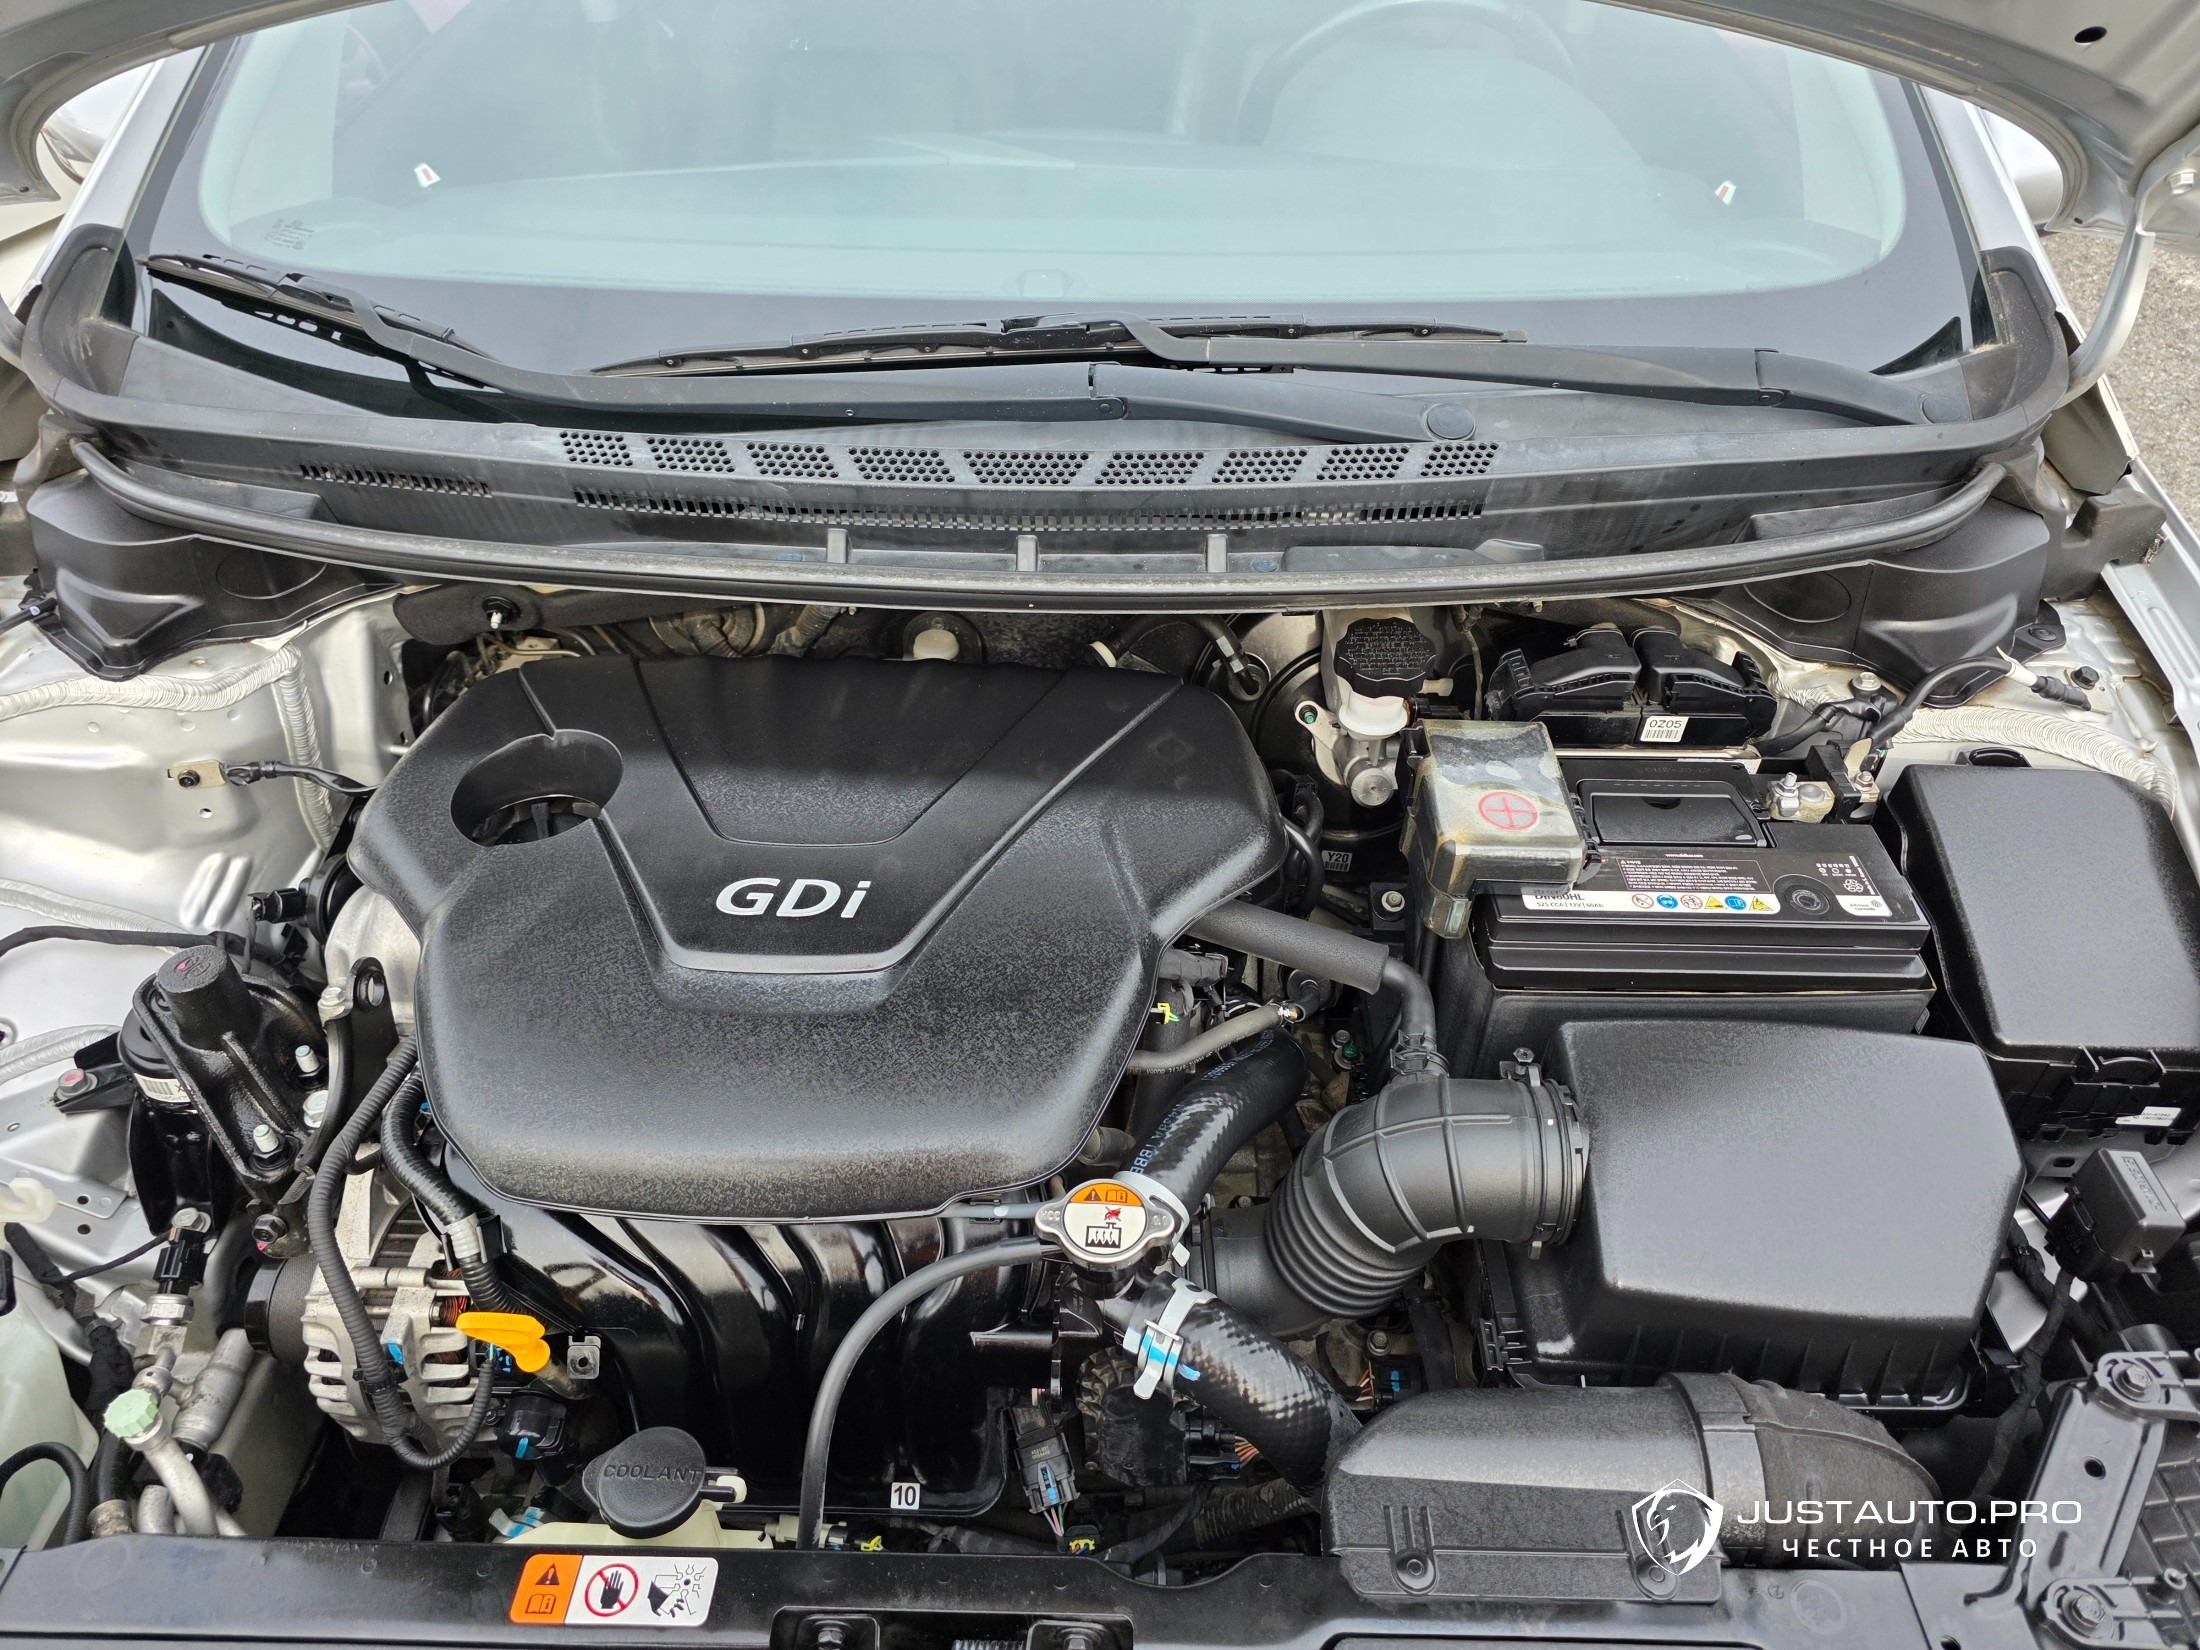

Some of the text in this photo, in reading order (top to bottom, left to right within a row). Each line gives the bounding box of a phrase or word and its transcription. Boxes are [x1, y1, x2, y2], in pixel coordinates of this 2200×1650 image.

[1327, 851, 1350, 864] Y20
[715, 877, 872, 919] GDi
[604, 1463, 702, 1485] COOLANT
[894, 1484, 917, 1507] 10
